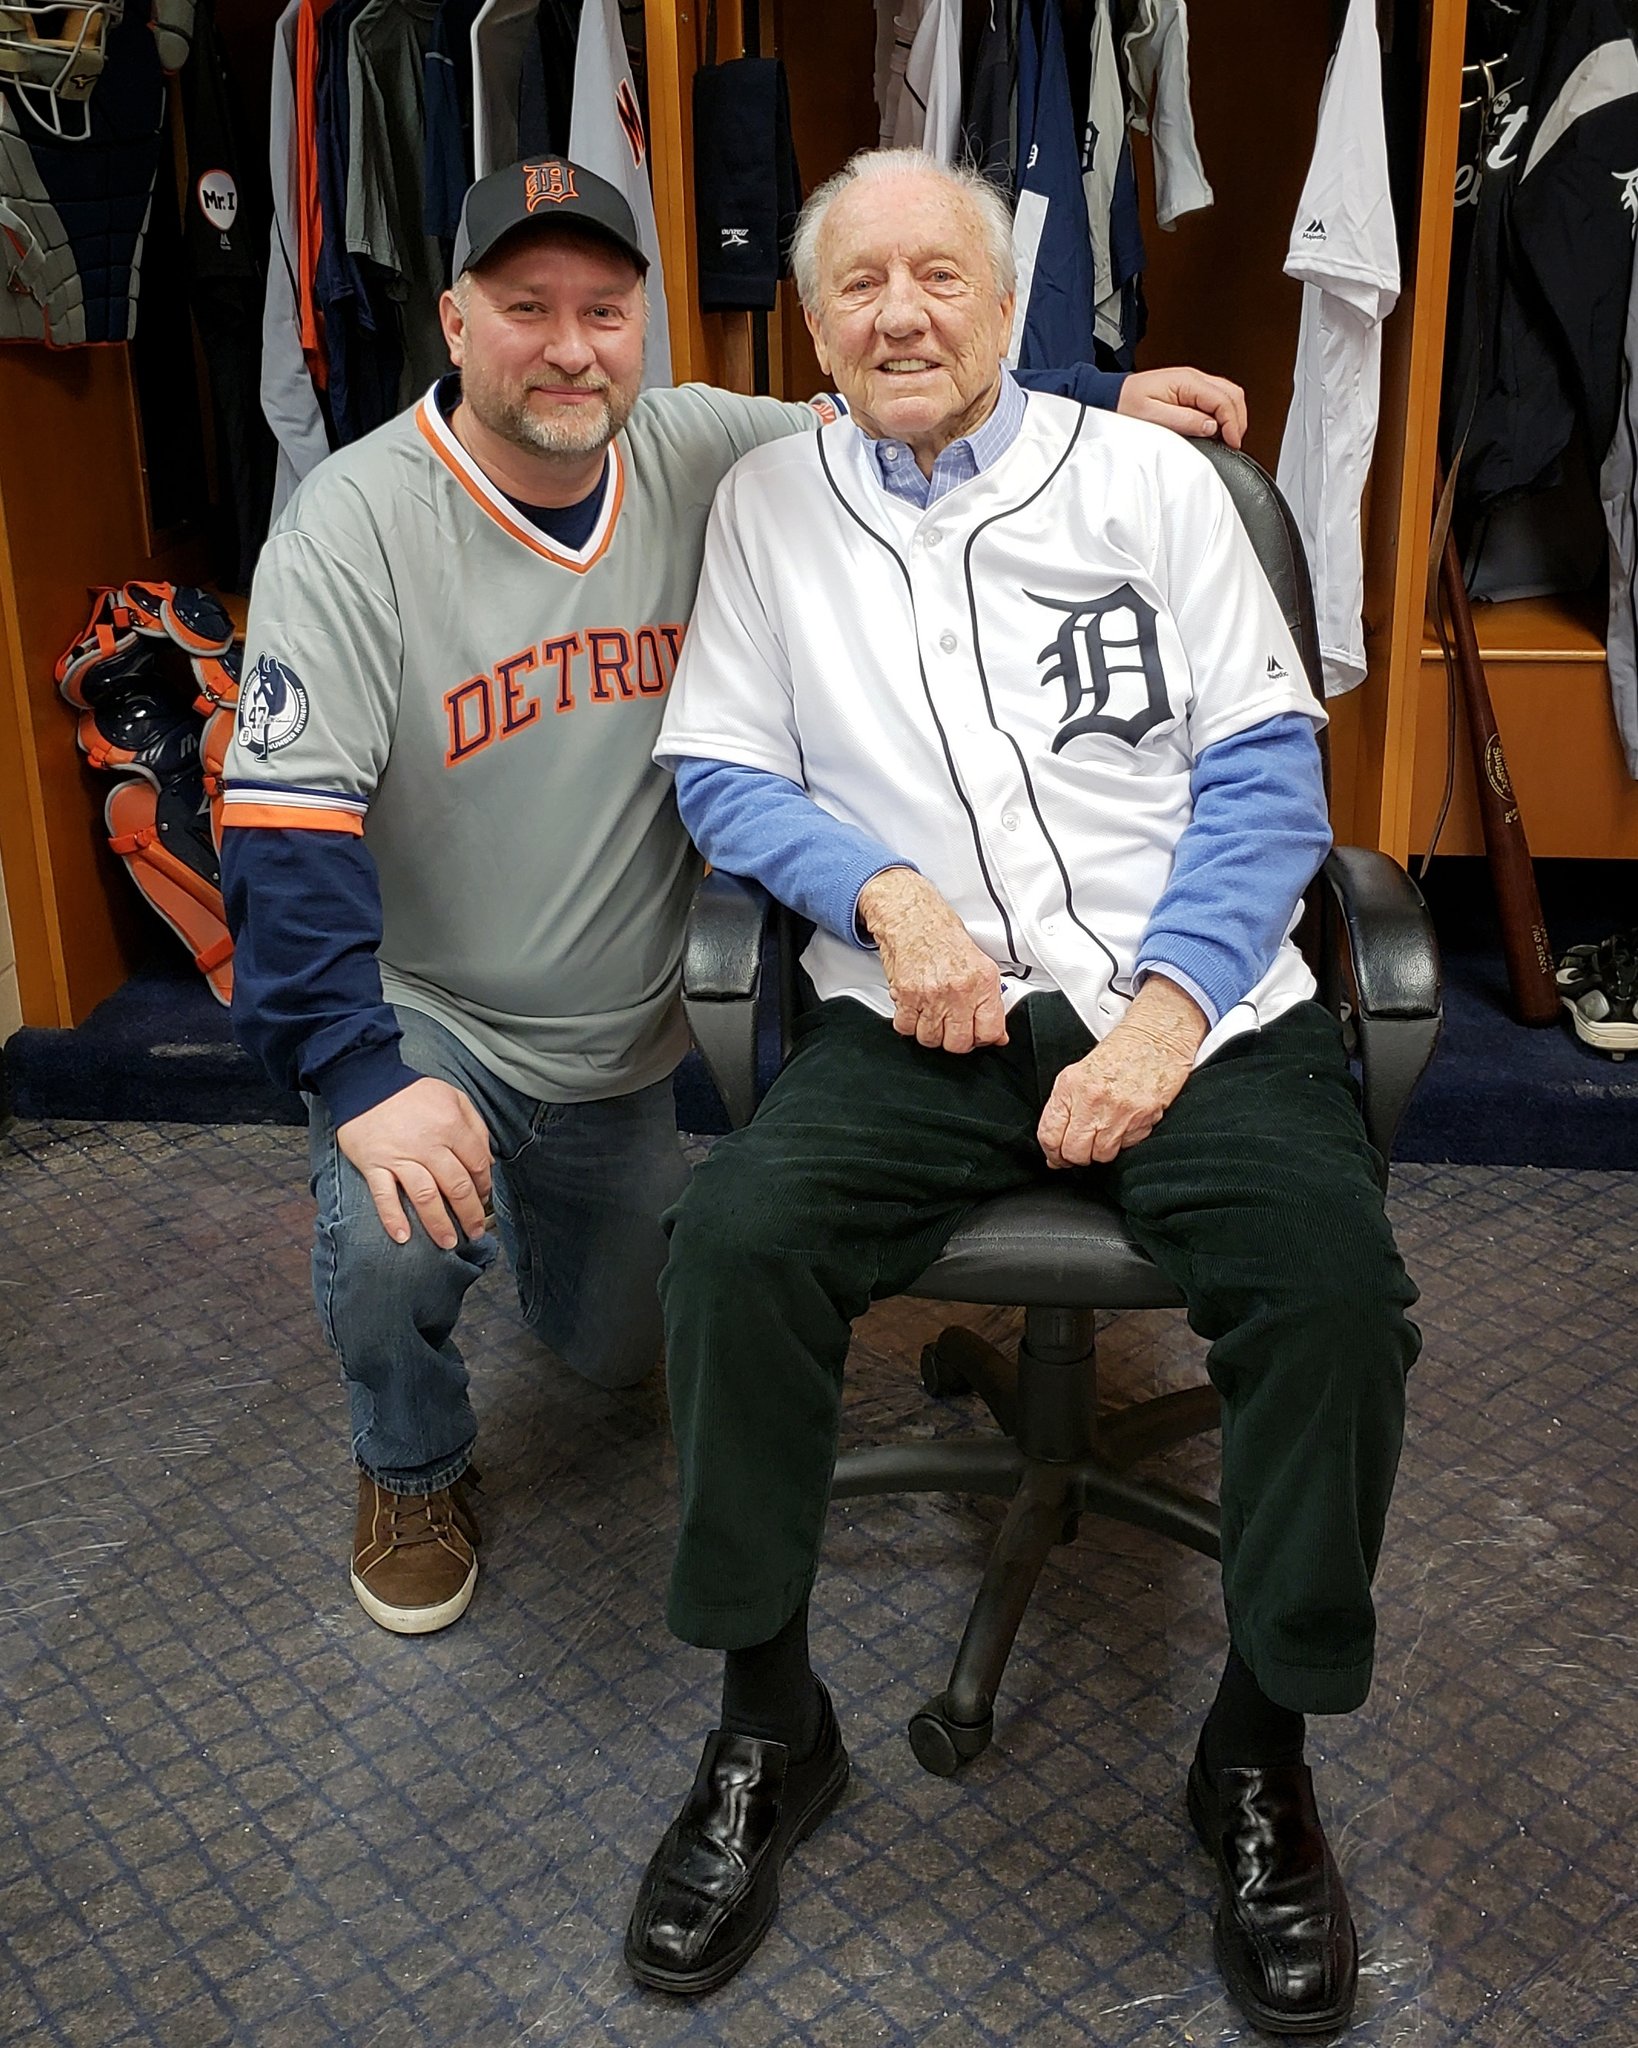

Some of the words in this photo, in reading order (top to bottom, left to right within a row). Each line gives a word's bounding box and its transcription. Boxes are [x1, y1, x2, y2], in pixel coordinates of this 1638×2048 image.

[522, 161, 579, 213] D
[1021, 581, 1176, 756] D
[248, 706, 267, 729] 47
[294, 687, 308, 734] RETIREMENT
[443, 623, 688, 769] DETROI
